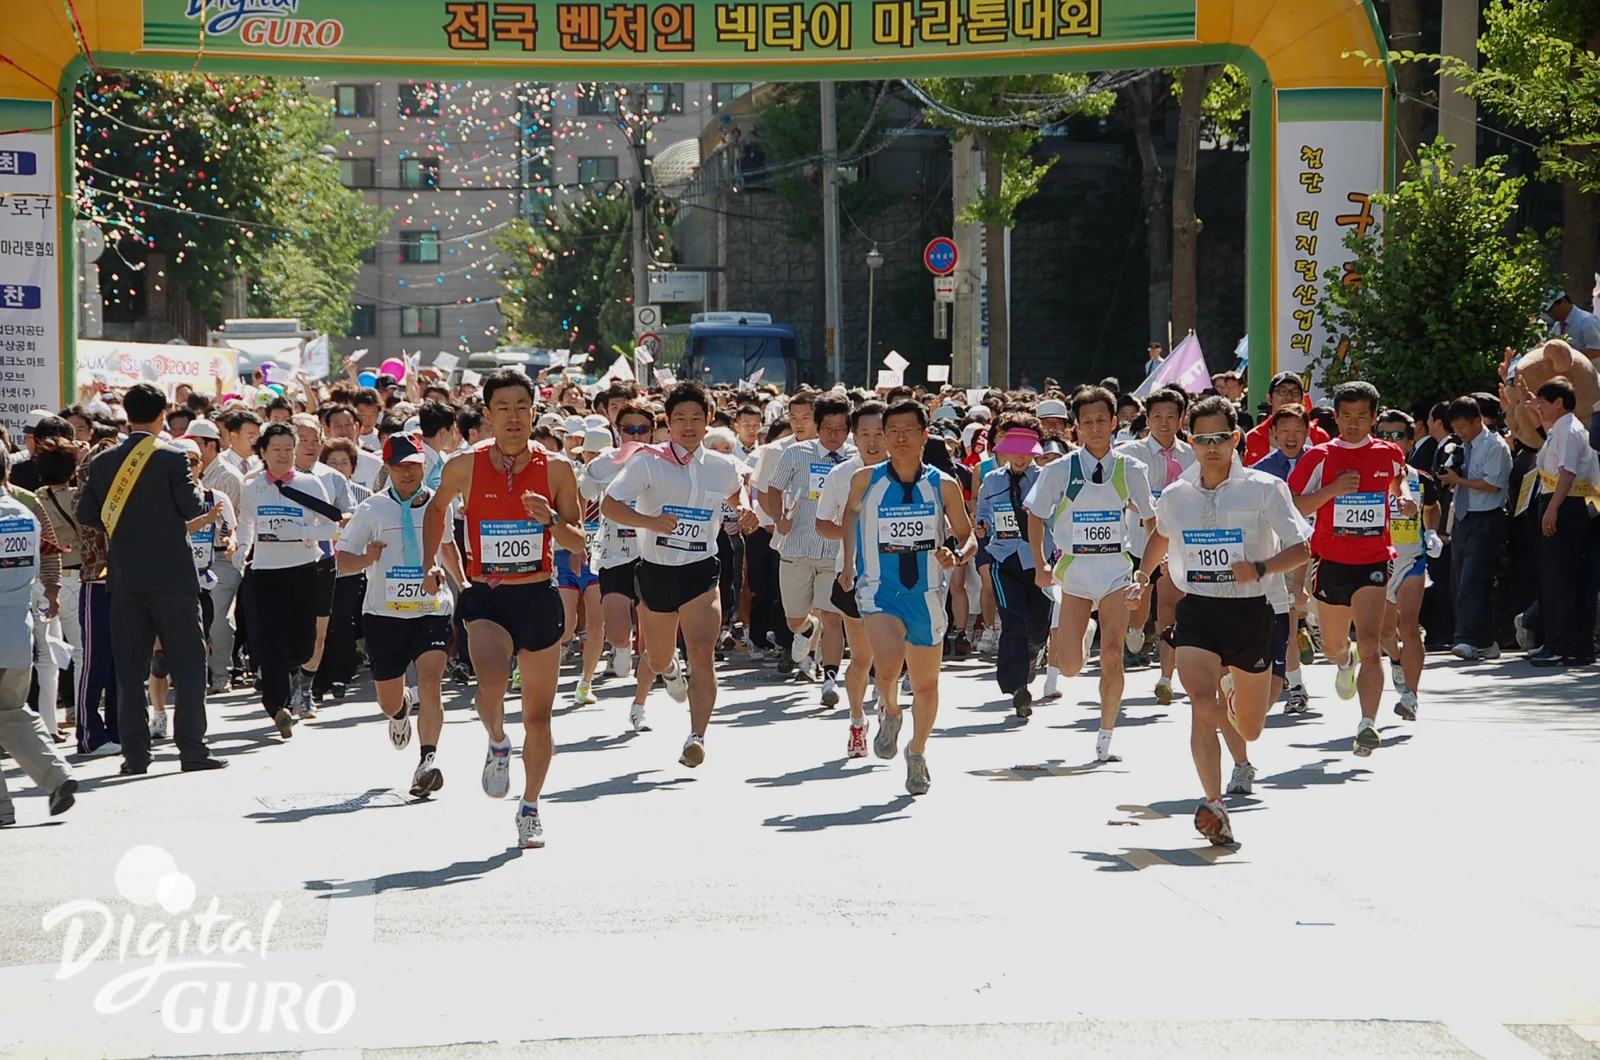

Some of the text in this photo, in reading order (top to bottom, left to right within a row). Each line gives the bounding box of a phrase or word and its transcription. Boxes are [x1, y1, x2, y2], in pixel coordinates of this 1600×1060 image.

[241, 19, 343, 47] GURO
[442, 0, 1102, 51] 전국 벤처인 넥타이 마라톤대회
[1300, 145, 1324, 194] 첨단
[1, 240, 54, 256] 마라톤협회
[1291, 211, 1319, 353] 디지털산업의
[4, 286, 25, 307] 찬
[169, 361, 200, 376] 2008
[1346, 509, 1375, 523] 2149
[890, 521, 924, 537] 3259
[1084, 526, 1111, 540] 1666
[5, 537, 27, 552] 2200
[495, 540, 530, 557] 1206
[1198, 549, 1229, 566] 1810
